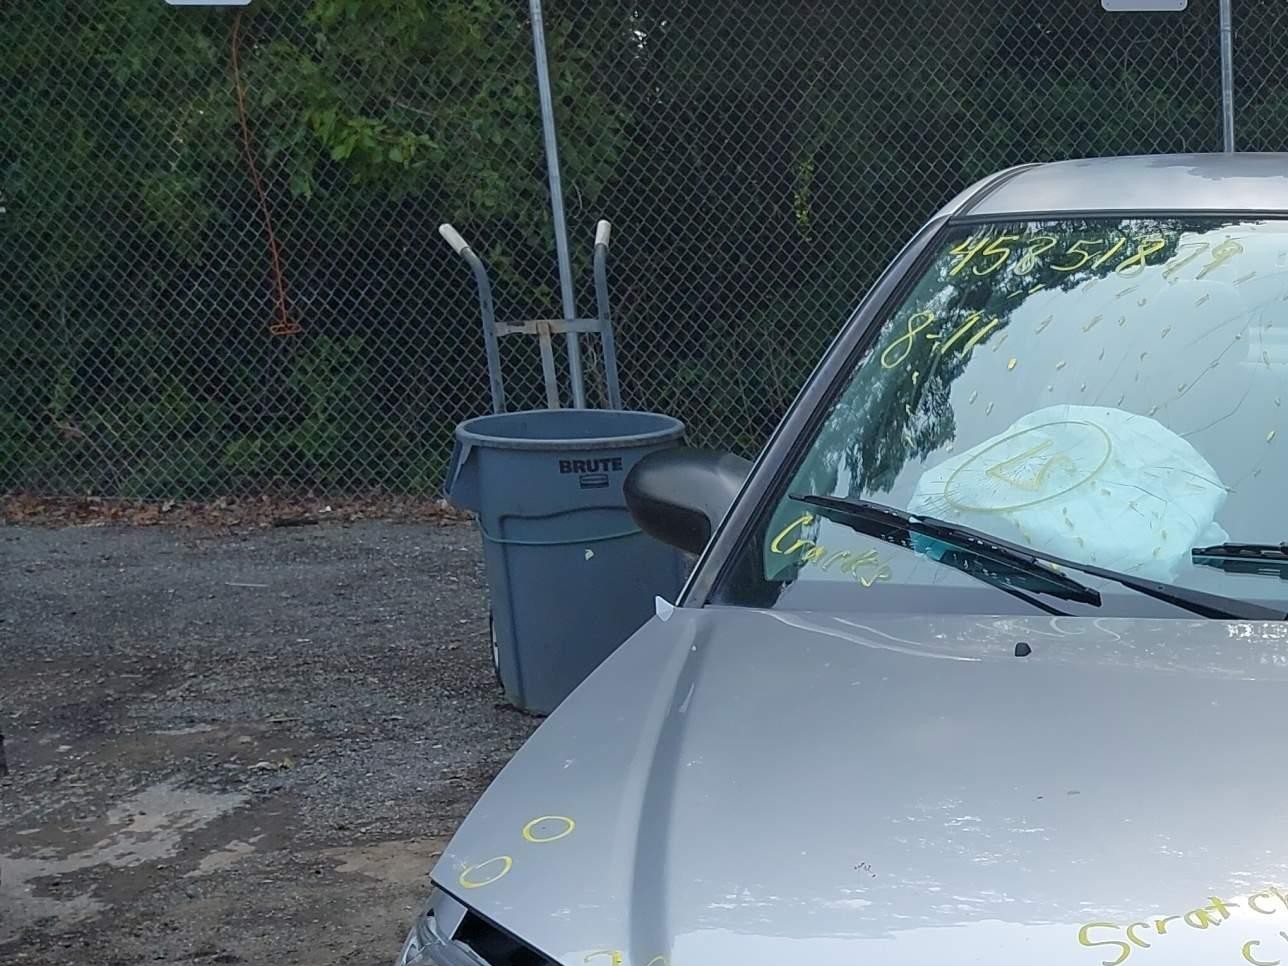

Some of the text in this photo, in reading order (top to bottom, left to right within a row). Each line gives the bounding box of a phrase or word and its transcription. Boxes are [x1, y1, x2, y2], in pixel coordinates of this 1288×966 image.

[948, 233, 1245, 279] 45851879
[881, 309, 1001, 369] 8-11
[558, 457, 623, 474] BRUTE
